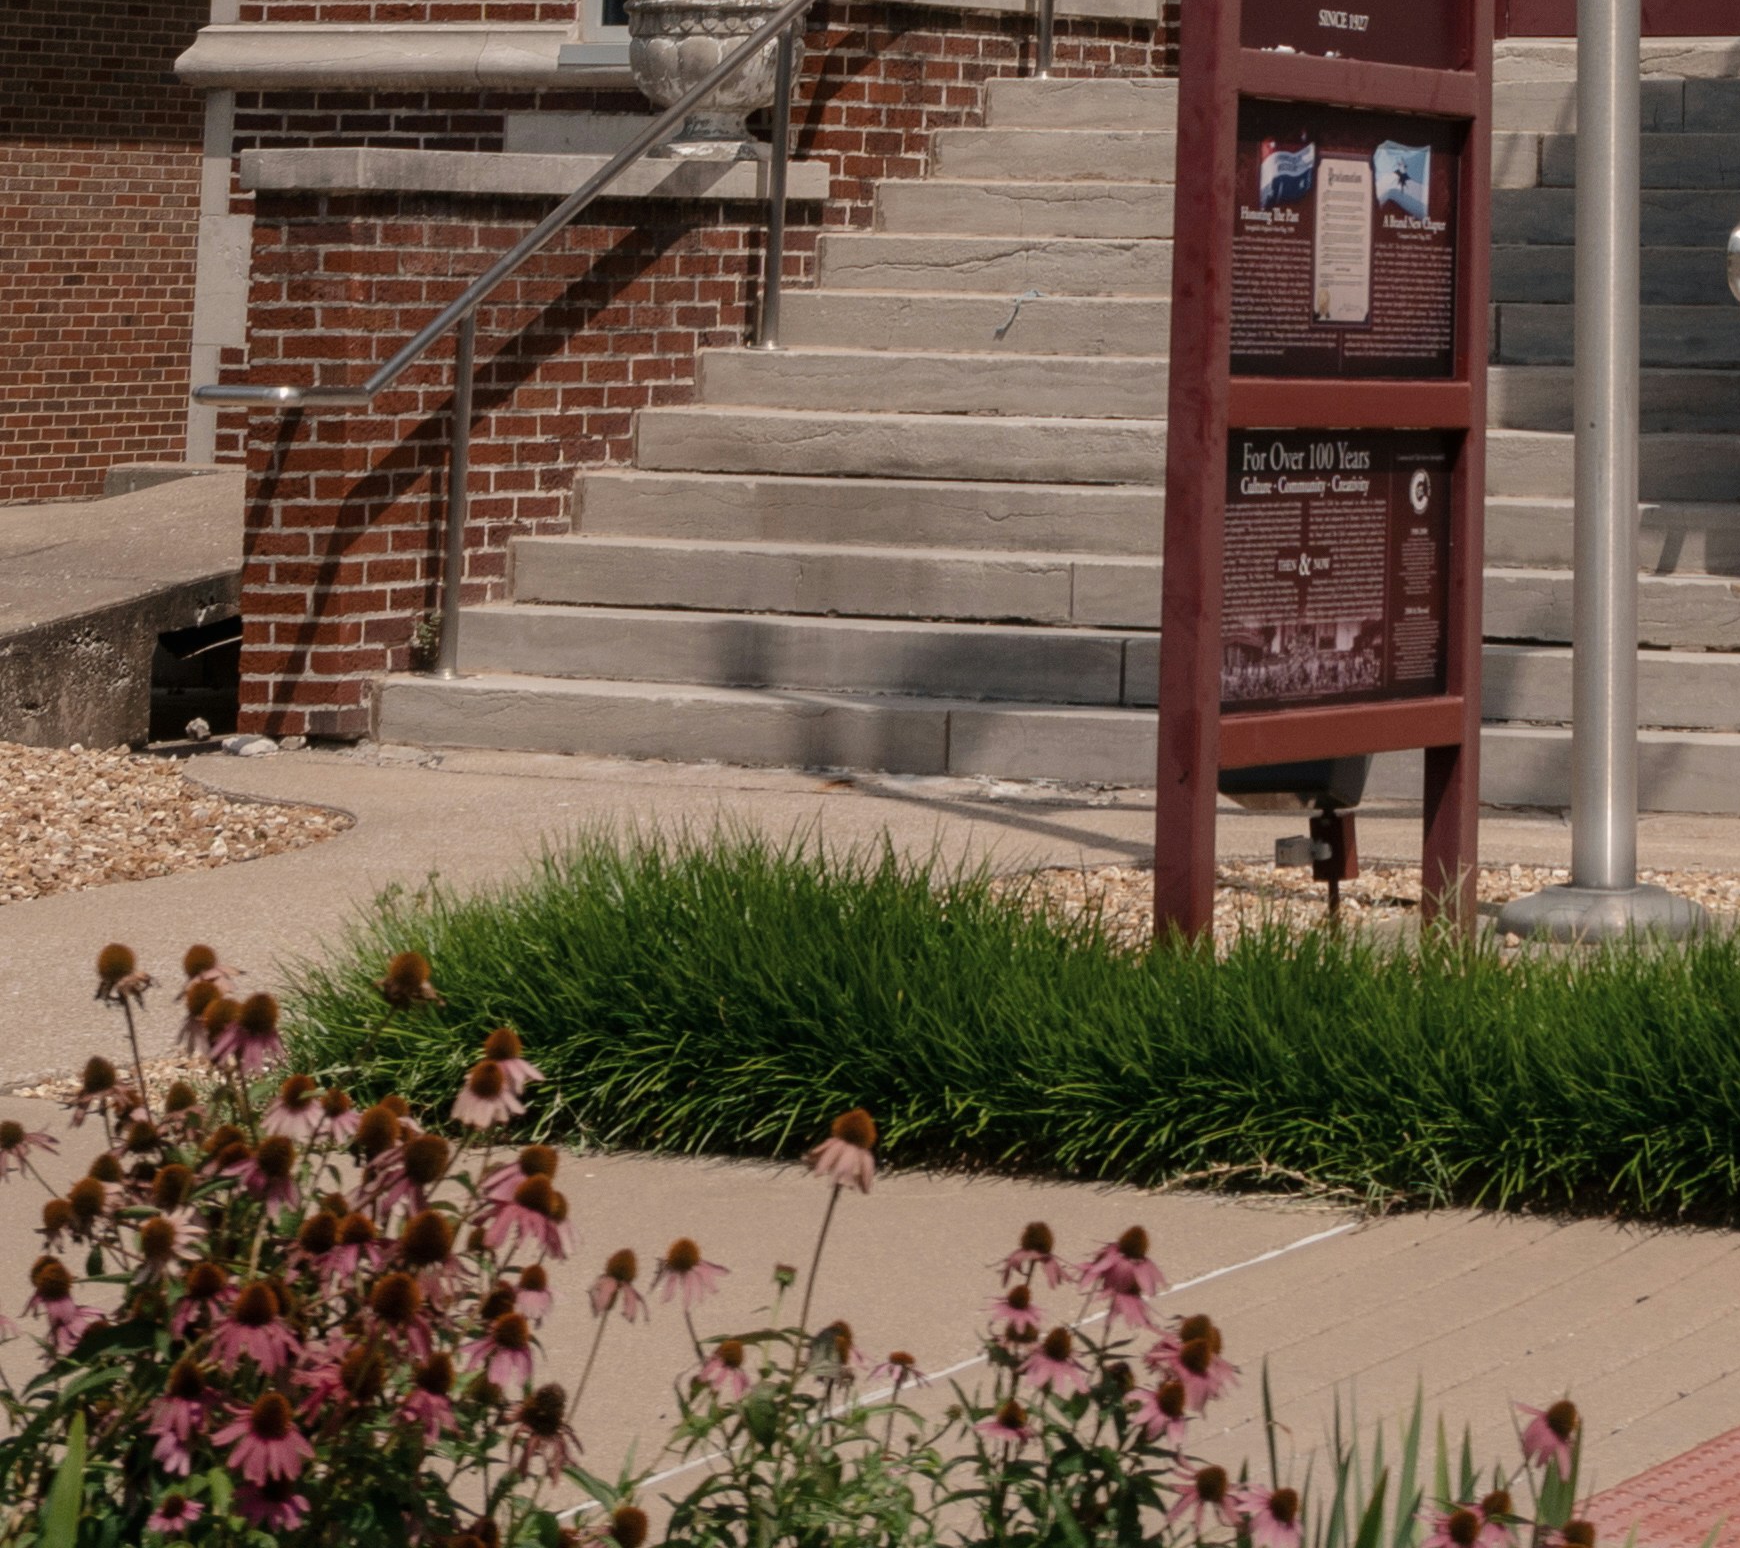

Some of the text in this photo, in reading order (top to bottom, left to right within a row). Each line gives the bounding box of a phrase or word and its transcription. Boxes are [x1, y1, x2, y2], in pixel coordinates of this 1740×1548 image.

[1318, 9, 1348, 28] SINCE
[1242, 441, 1371, 471] For Over 100 Years
